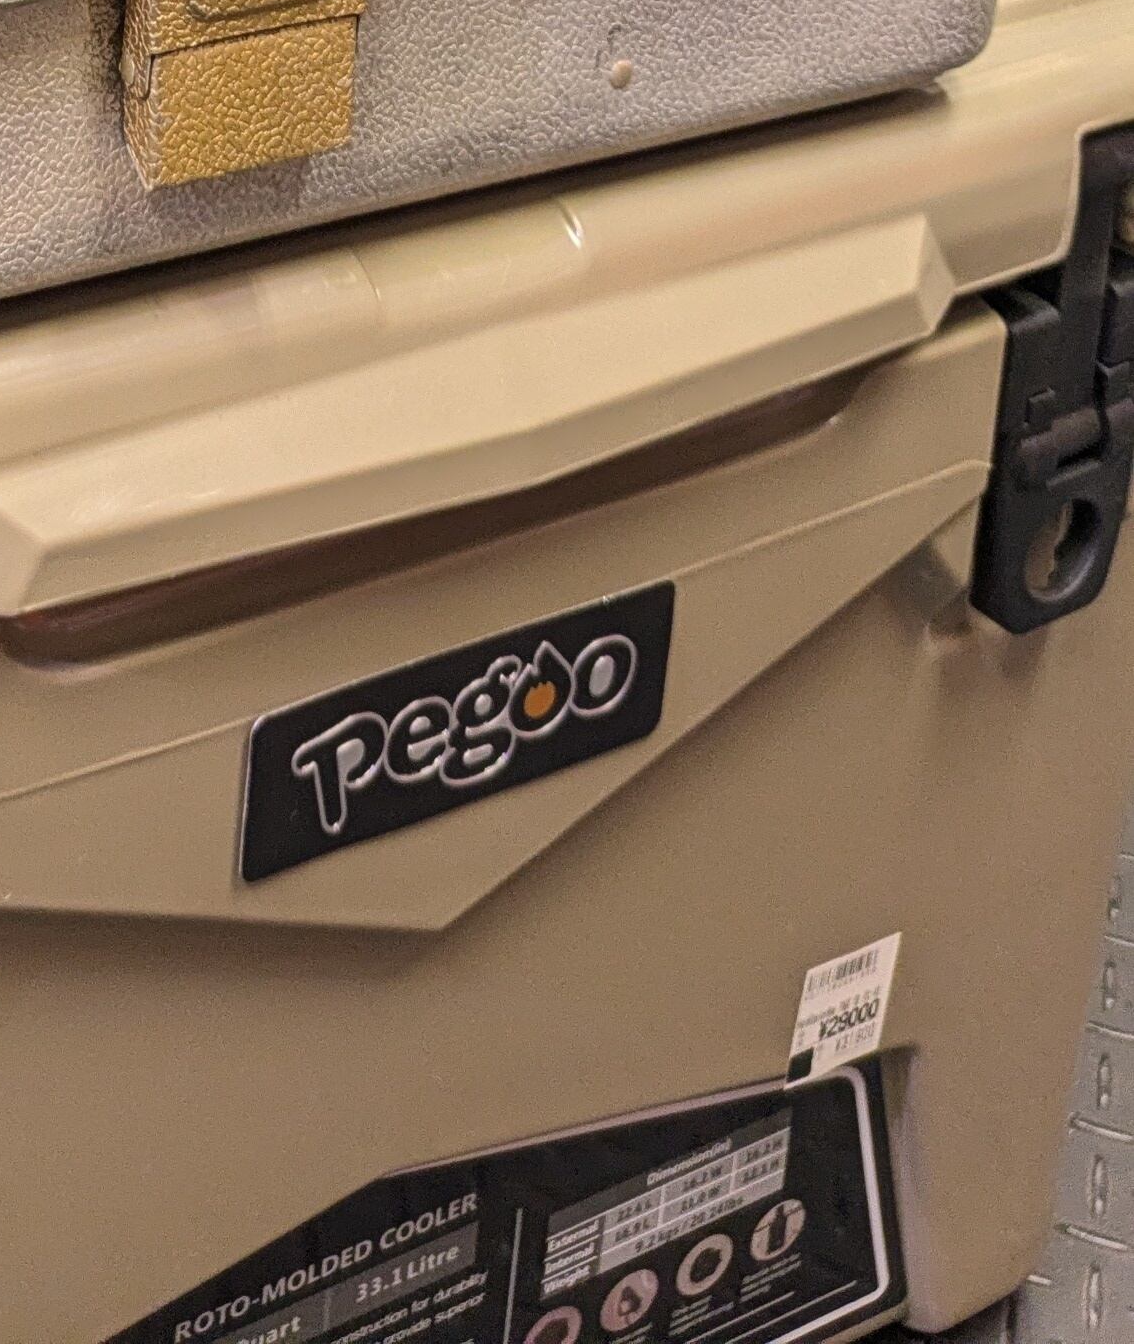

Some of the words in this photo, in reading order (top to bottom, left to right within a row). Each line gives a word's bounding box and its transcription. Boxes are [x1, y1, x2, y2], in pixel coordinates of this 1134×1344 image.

[173, 1239, 373, 1344] ROTO-MOLDED
[379, 1192, 478, 1252] COOLER
[355, 1266, 403, 1305] 33.1
[406, 1244, 460, 1281] Litre
